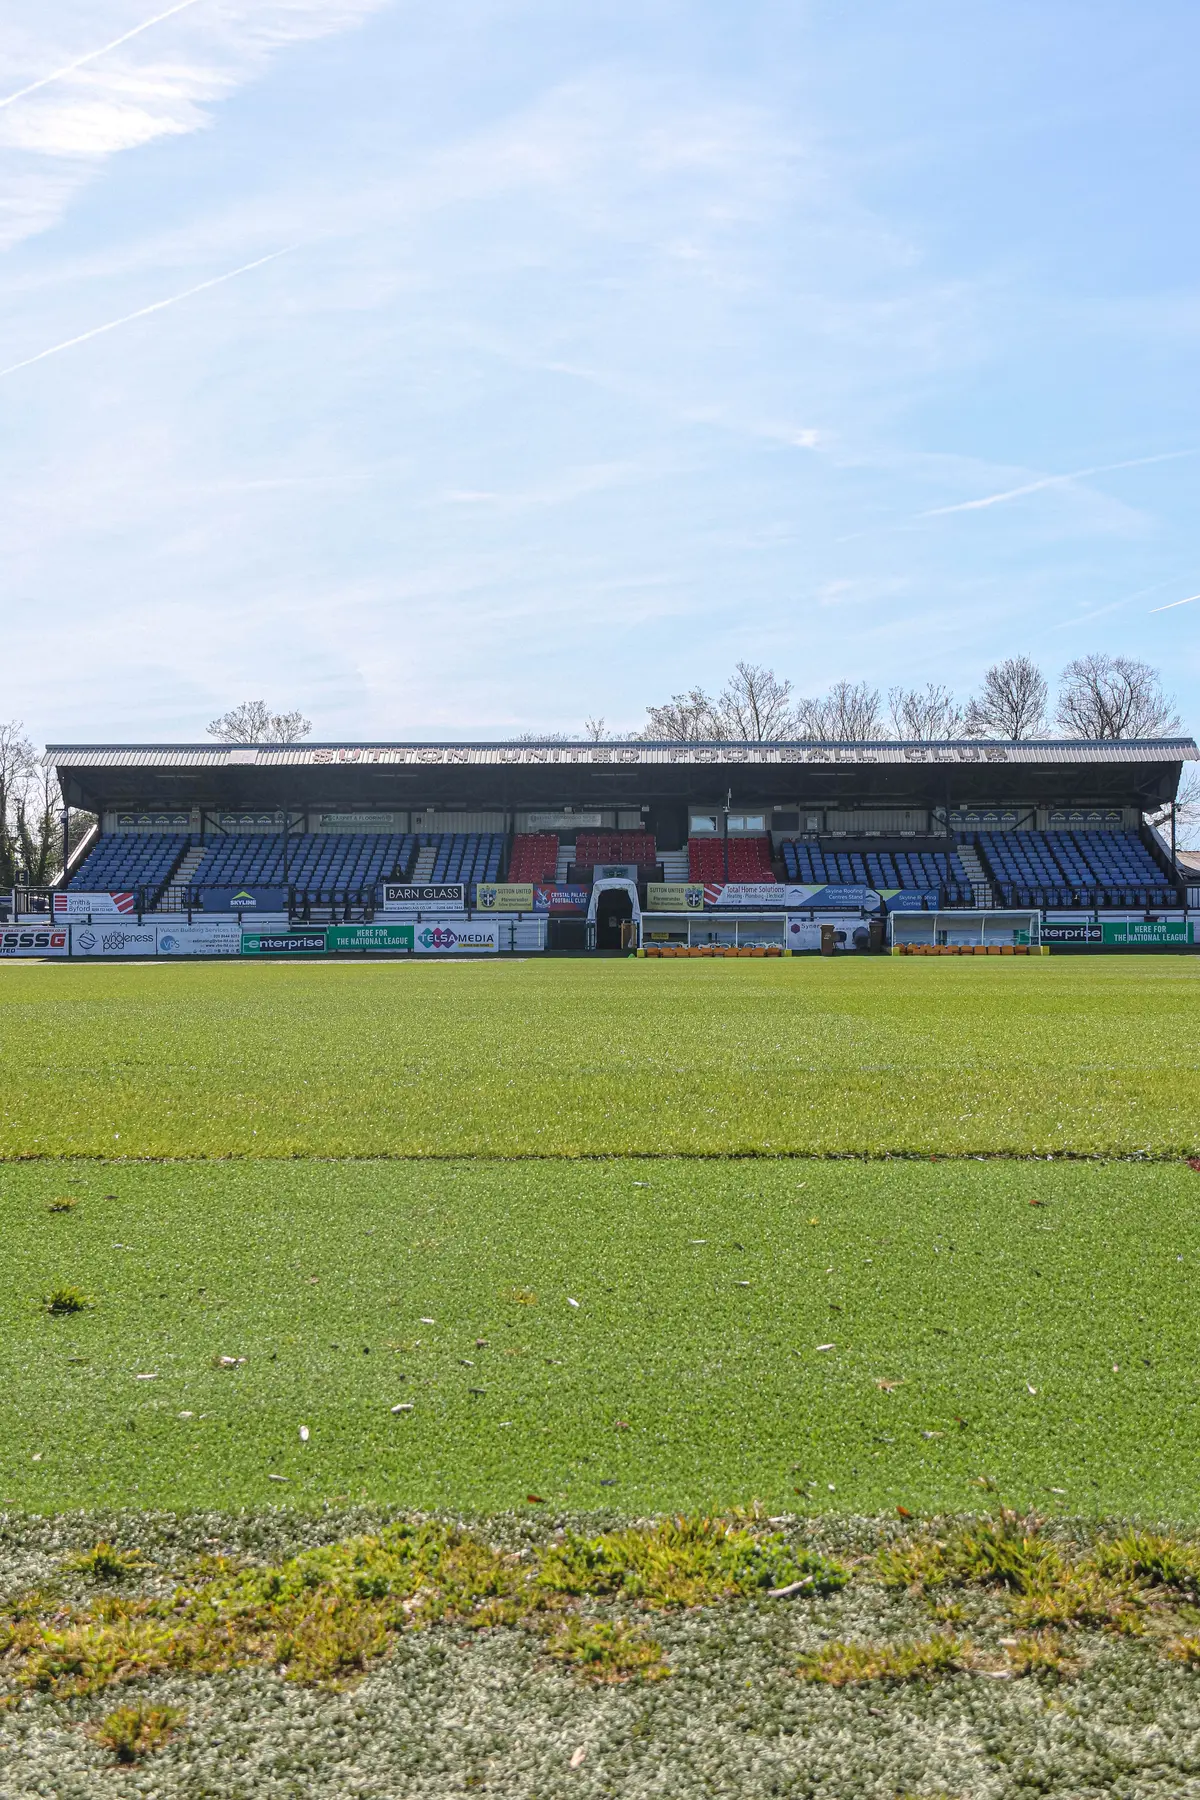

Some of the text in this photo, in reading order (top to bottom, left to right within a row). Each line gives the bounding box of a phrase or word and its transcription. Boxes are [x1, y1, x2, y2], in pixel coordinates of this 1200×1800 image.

[313, 748, 1008, 762] SUTTON UNITED FOOTBALL CLUB
[19, 873, 25, 882] E
[389, 888, 459, 899] BARN GLASS
[759, 885, 785, 893] Solutions
[0, 933, 67, 947] SSSG
[101, 933, 154, 943] wholeness
[350, 937, 382, 945] NATIONAL
[1128, 933, 1160, 941] NATIONAL
[1162, 933, 1187, 941] LEAGUE
[103, 941, 125, 952] pod
[248, 938, 324, 950] enterprise
